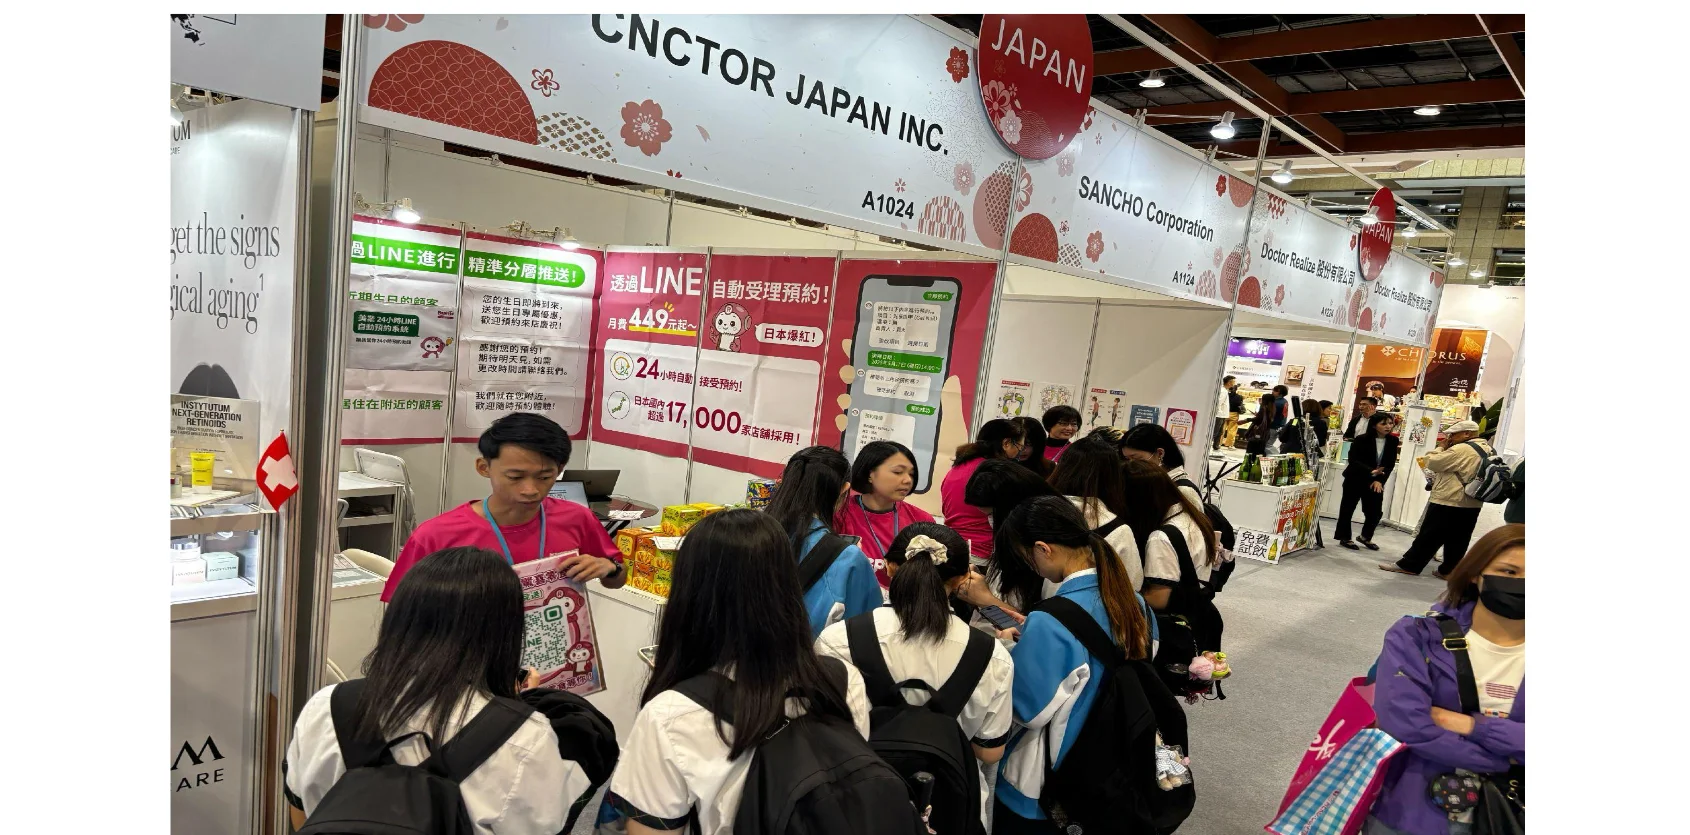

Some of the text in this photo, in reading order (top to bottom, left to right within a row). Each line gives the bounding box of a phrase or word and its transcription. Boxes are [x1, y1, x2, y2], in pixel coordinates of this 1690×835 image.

[991, 18, 1085, 94] JAPAN
[591, 13, 948, 156] CNCTOR JAPAN INC.
[861, 190, 915, 220] A1024
[1079, 175, 1214, 243] SANCHO Corporation
[197, 211, 226, 255] the
[231, 213, 280, 269] signs
[1365, 223, 1393, 244] JAPAN
[351, 240, 456, 269] 過LINE進行
[1260, 242, 1356, 287] Doctor Realize 股份有限公司
[468, 256, 576, 283] 精準分層推送！
[1172, 270, 1195, 286] A1124
[610, 266, 829, 305] 透過LINE 自動受理預約！
[764, 327, 816, 343] 日本爆紅！
[635, 356, 743, 393] 24小時自動 接受預約！
[172, 408, 242, 422] NEXT-GENERATION
[180, 401, 231, 413] INSTYTUTUM
[186, 417, 227, 429] RETINOIDS
[1239, 542, 1268, 559] 試飲
[1242, 530, 1270, 546] 免費
[176, 768, 225, 793] ARE
